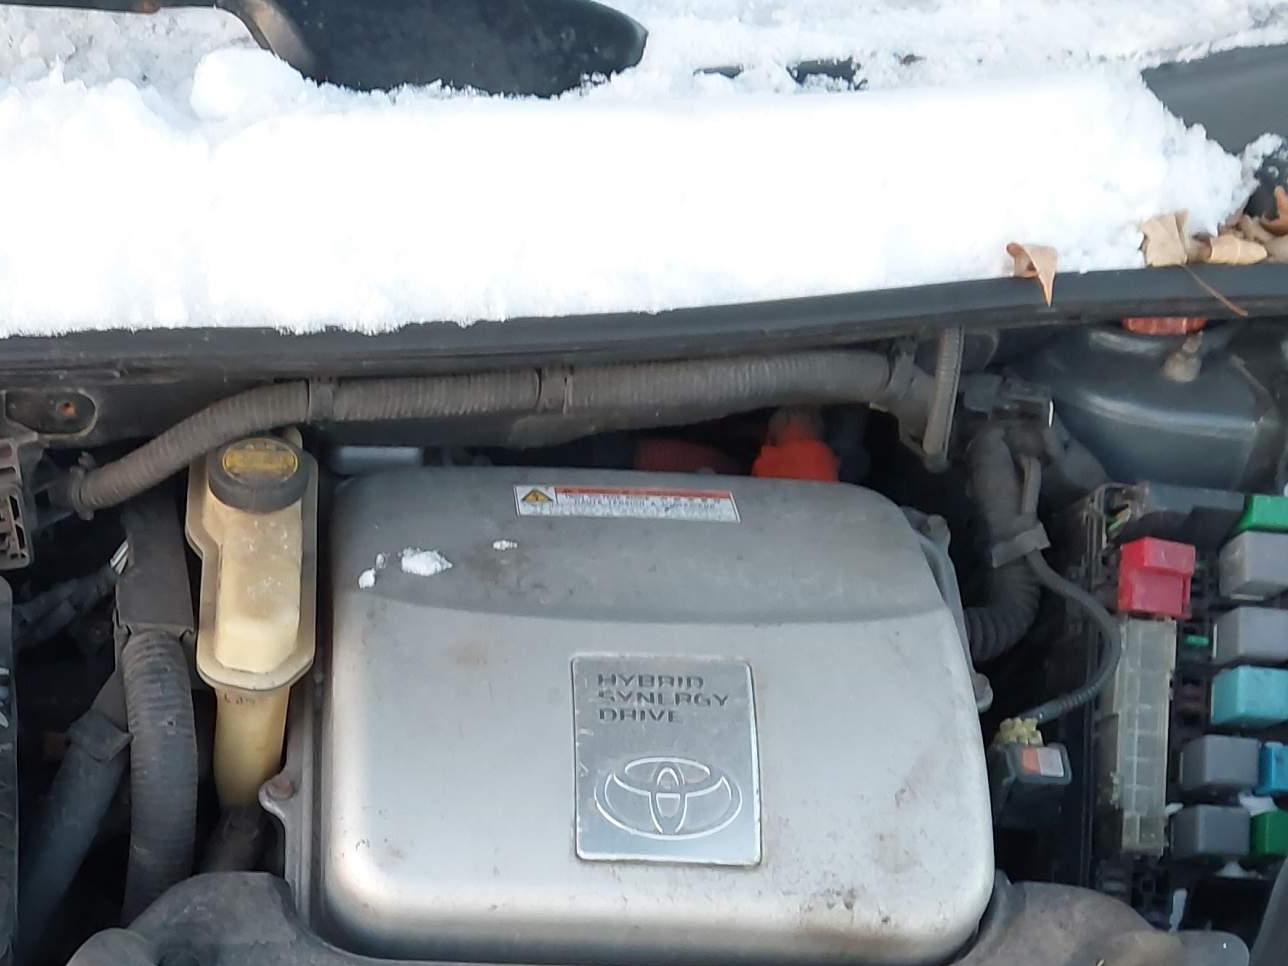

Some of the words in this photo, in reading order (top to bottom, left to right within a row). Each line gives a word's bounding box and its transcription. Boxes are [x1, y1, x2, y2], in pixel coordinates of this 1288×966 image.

[598, 674, 704, 689] HYBRID
[598, 690, 729, 707] SYNERGY
[599, 708, 681, 722] DRIVE
